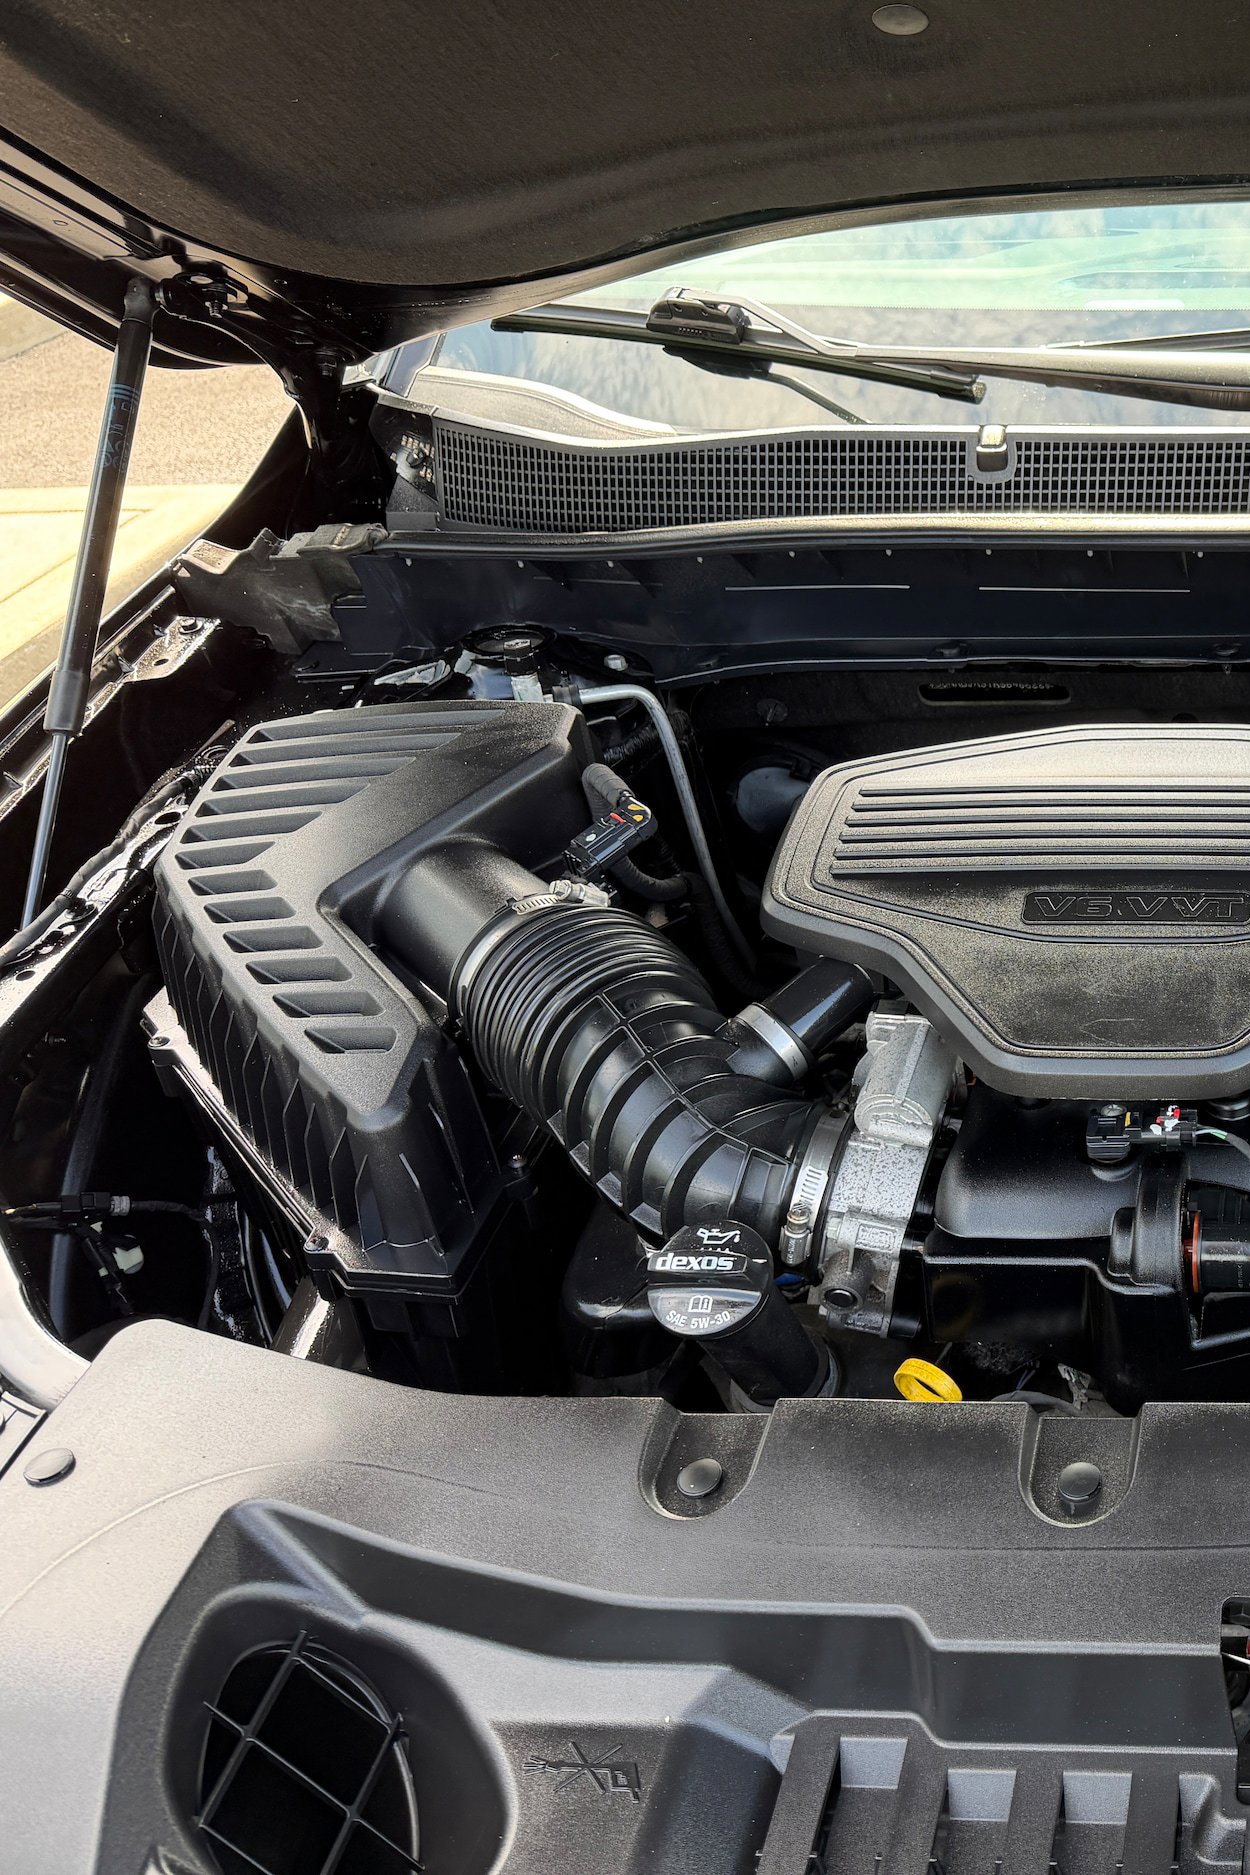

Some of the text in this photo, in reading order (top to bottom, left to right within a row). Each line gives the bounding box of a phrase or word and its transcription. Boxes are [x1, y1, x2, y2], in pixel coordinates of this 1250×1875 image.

[1034, 896, 1243, 918] V6 VVT
[655, 1252, 735, 1271] dexos
[666, 1310, 731, 1328] SAE 5W-30
